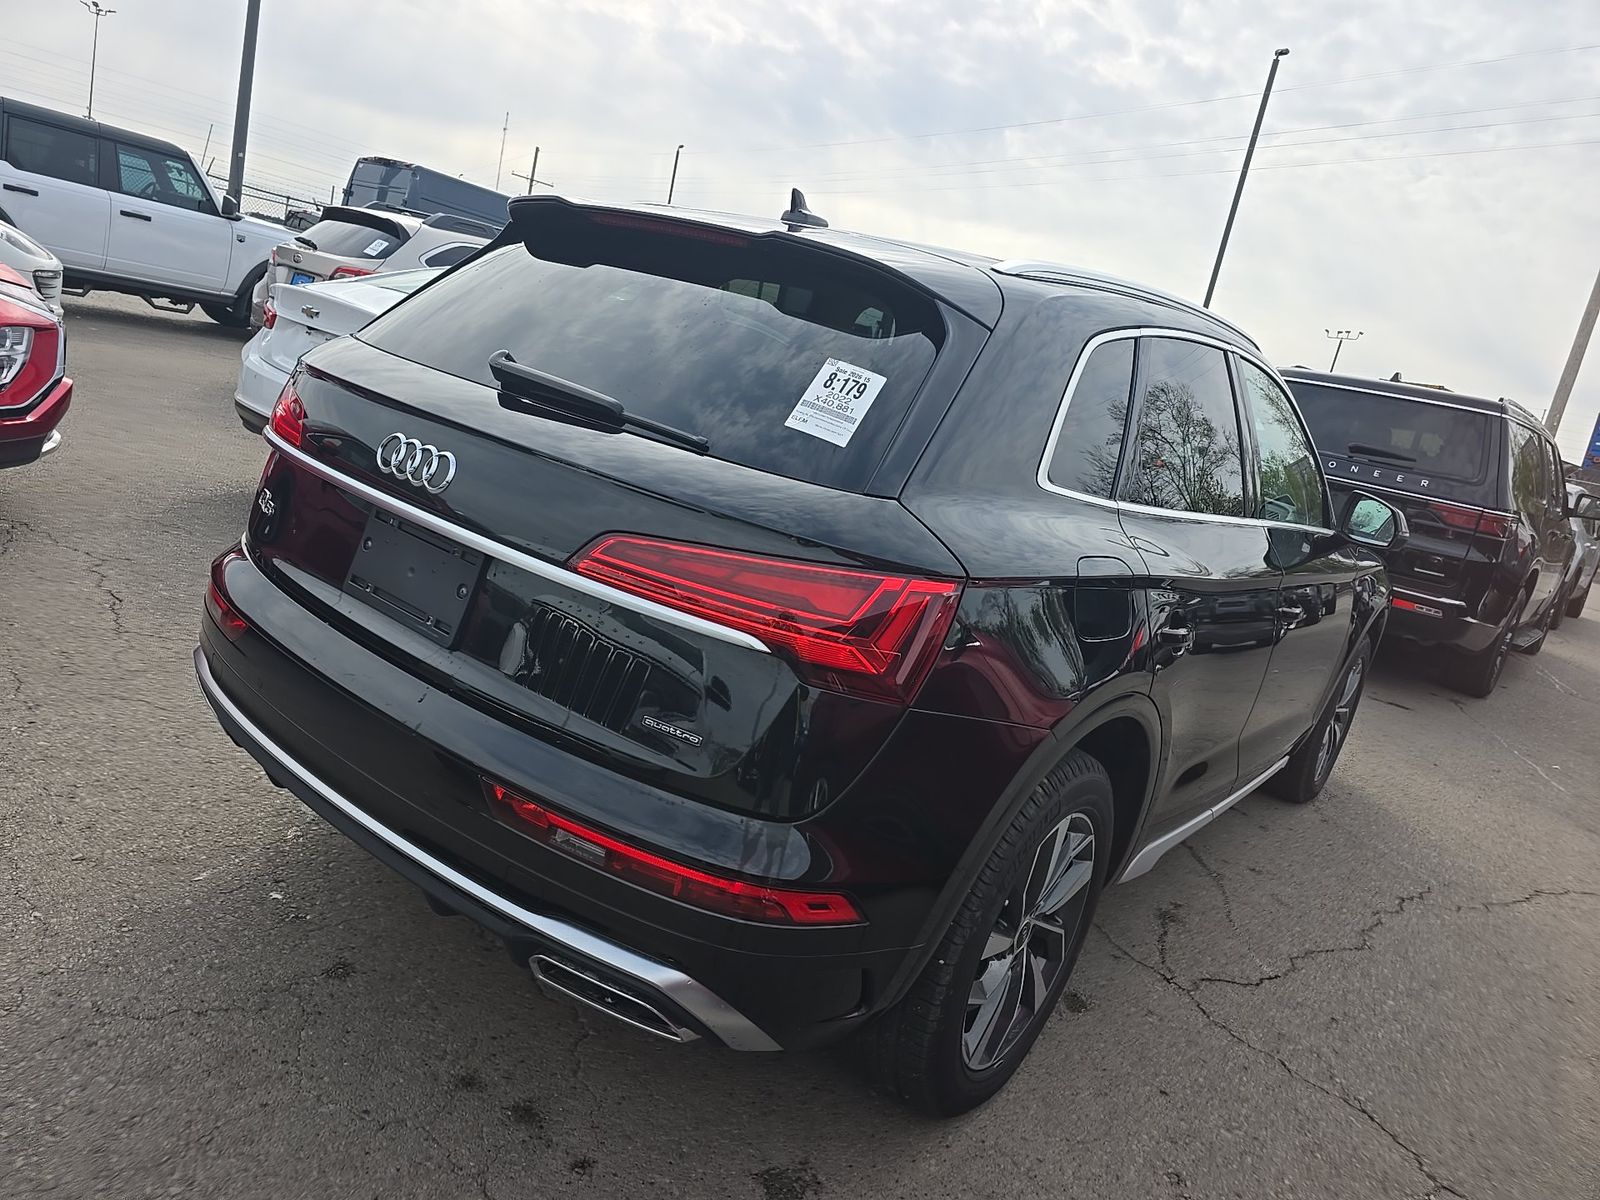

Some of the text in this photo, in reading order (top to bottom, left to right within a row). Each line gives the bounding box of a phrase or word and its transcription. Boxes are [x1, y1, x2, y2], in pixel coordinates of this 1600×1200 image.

[835, 366, 848, 375] Sale
[823, 372, 867, 399] 8:179
[826, 391, 852, 405] 2022
[1328, 461, 1429, 488] ONEER
[644, 718, 699, 743] quattro
